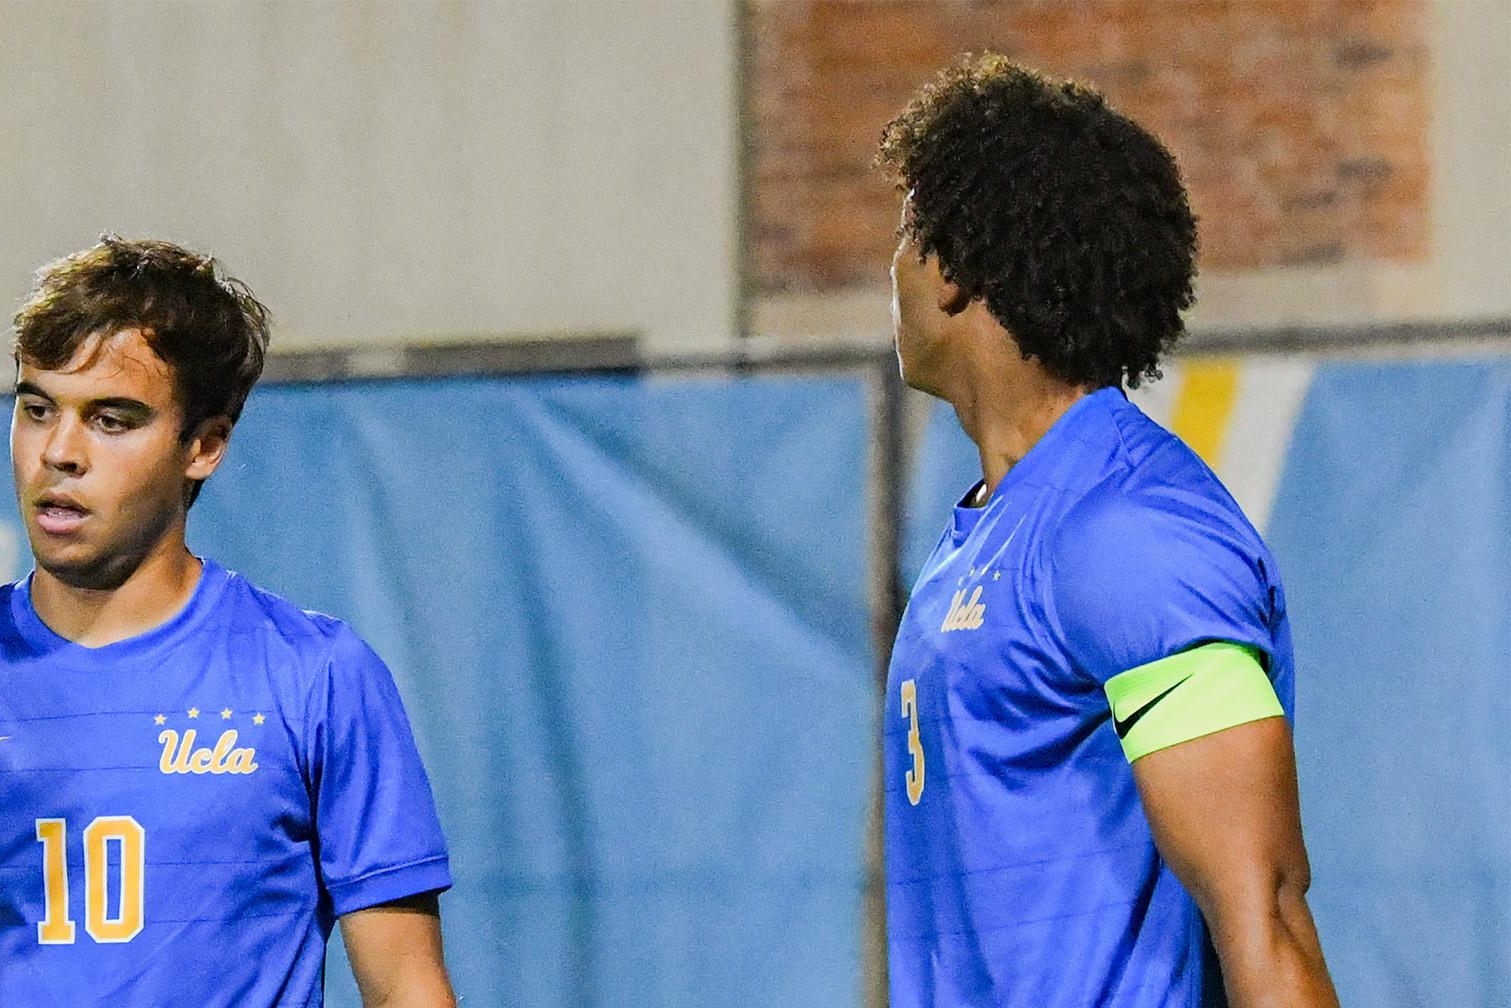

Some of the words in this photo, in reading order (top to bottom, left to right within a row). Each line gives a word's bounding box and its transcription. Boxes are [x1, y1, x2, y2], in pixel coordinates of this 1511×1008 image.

[158, 729, 258, 774] Ucla
[900, 678, 925, 806] 3
[35, 816, 145, 944] 10
